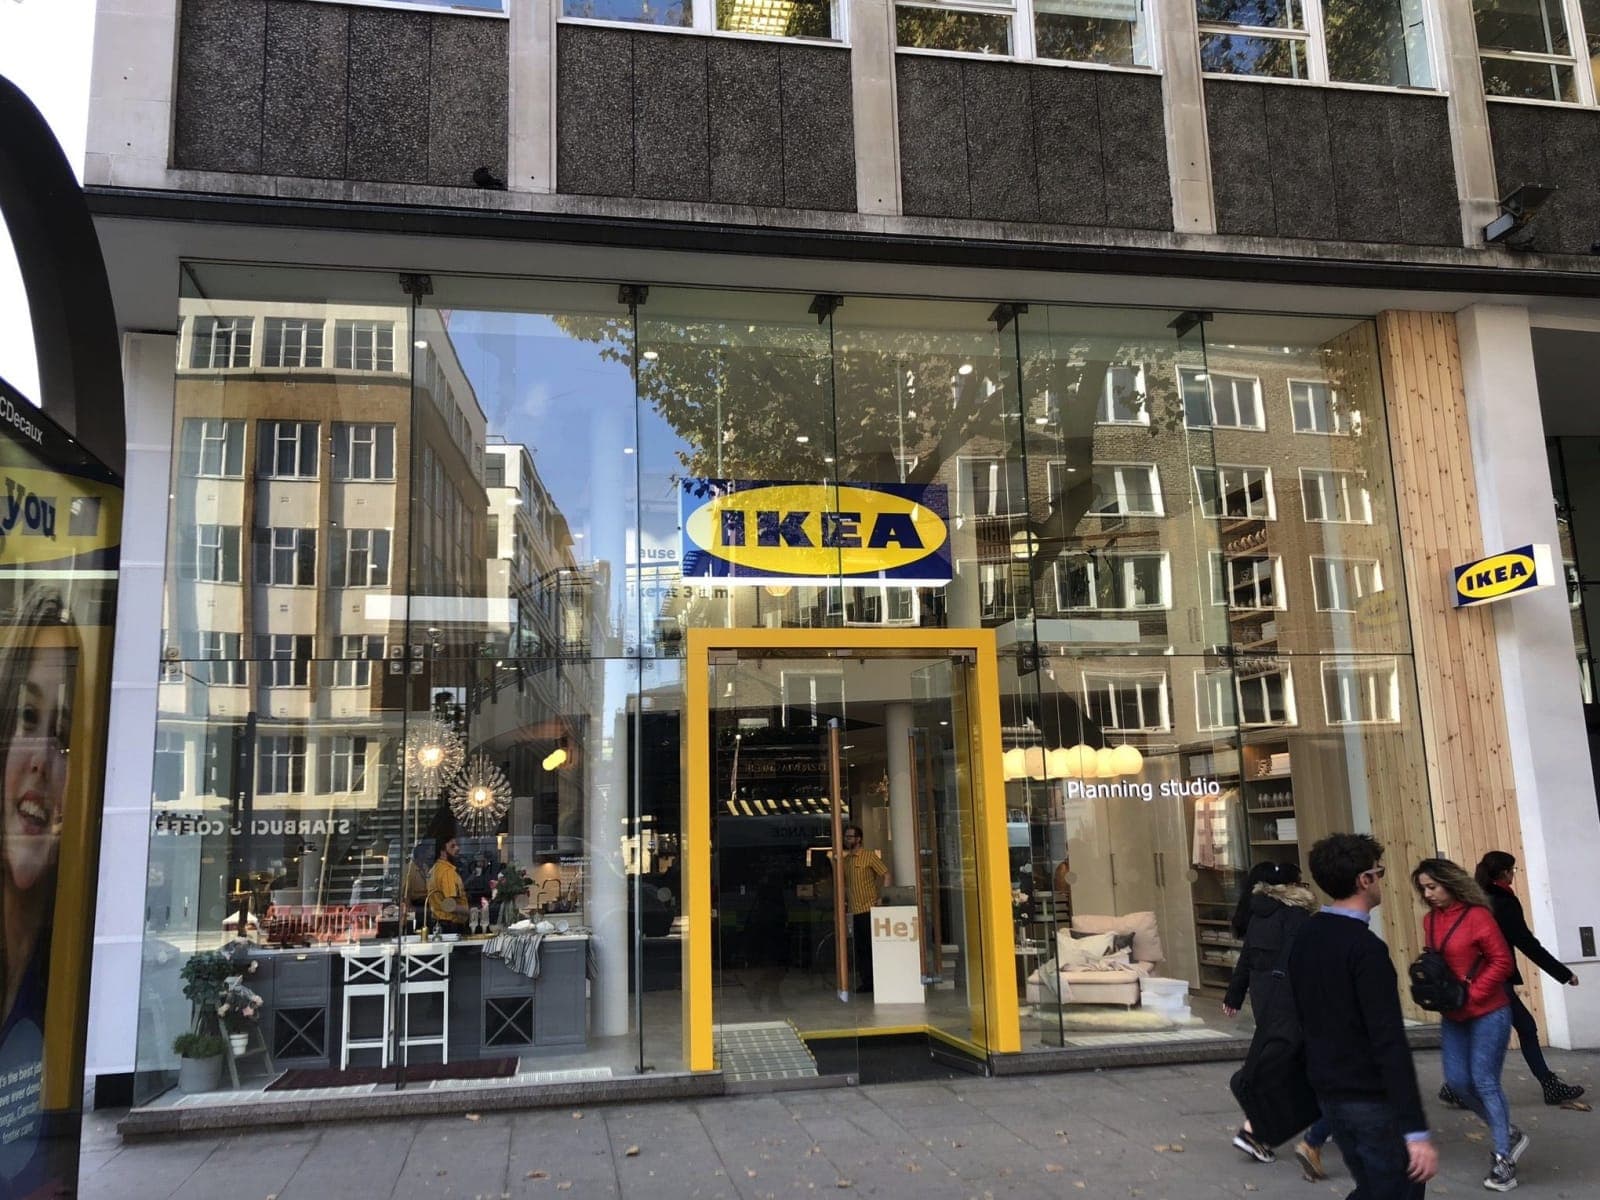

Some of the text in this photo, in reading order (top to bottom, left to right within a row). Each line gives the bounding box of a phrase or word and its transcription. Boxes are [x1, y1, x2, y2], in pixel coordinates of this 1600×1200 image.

[3, 477, 56, 542] you
[720, 509, 925, 549] IKEA
[1466, 561, 1528, 591] IKEA
[683, 585, 693, 598] 3
[1066, 778, 1221, 802] Planning studio
[873, 916, 919, 942] Hej
